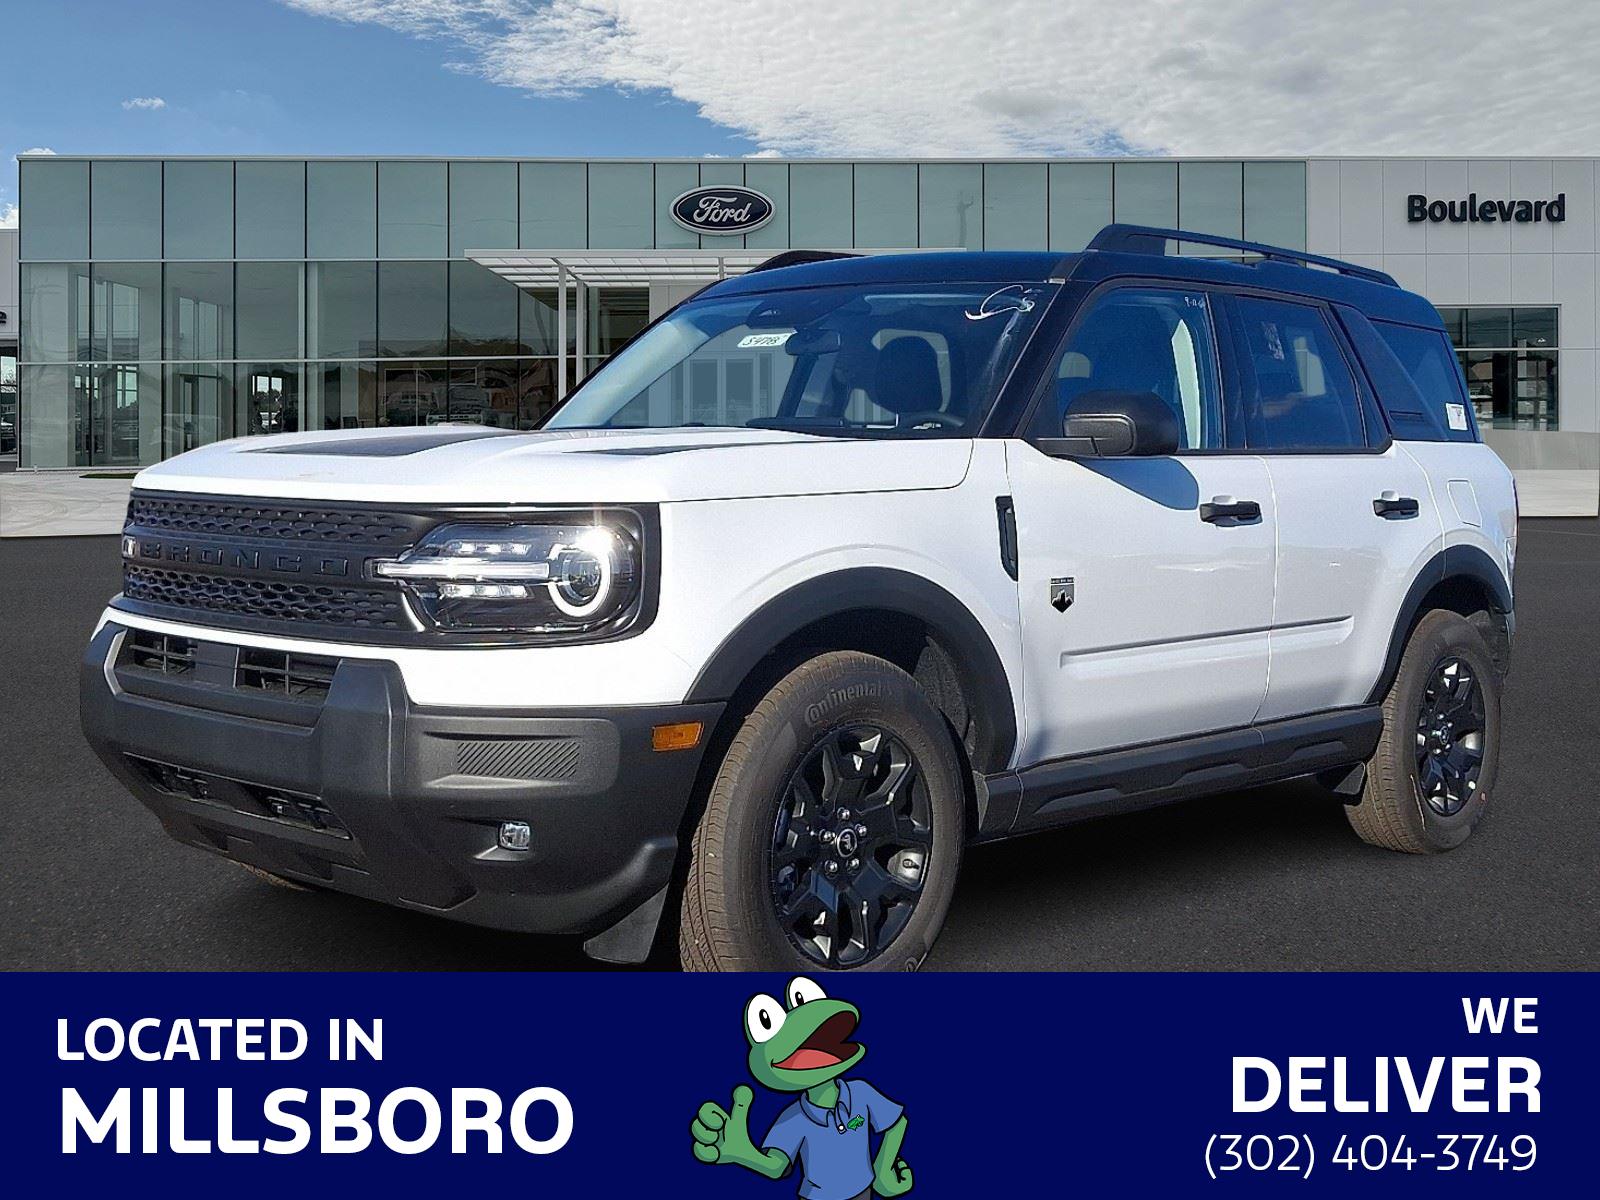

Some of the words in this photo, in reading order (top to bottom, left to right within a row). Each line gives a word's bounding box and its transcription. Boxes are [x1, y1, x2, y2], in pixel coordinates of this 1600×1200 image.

[693, 196, 752, 223] Ford
[1408, 193, 1565, 223] Boulevard
[140, 543, 348, 576] BRONCO
[804, 680, 883, 729] Continental
